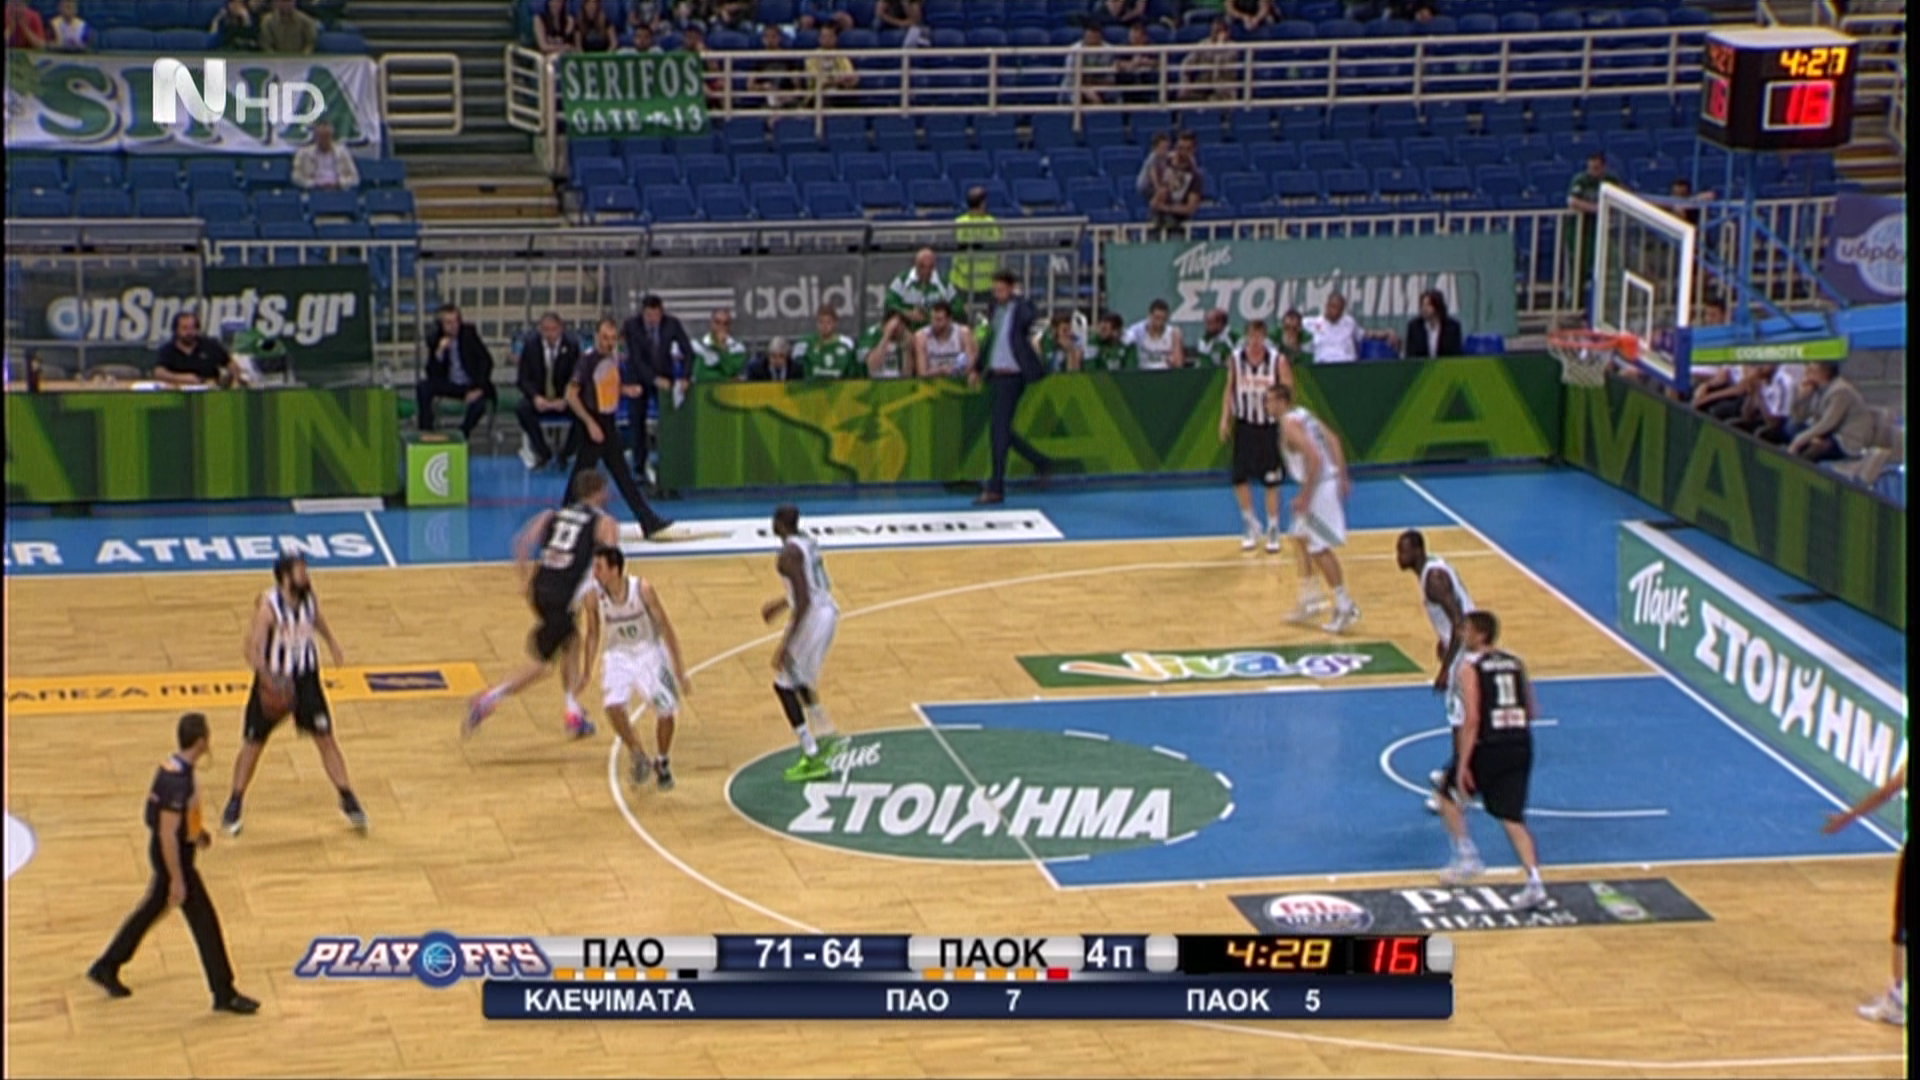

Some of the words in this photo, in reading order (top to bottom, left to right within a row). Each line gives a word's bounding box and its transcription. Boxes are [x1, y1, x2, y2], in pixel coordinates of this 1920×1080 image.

[565, 55, 700, 101] SERIFOS
[1779, 47, 1848, 77] 4:27
[573, 108, 642, 134] GATE
[1787, 82, 1834, 125] 16
[745, 275, 886, 320] adida
[97, 533, 375, 563] ATHENS
[1628, 560, 1689, 651] Πάμε
[1694, 599, 1905, 790] ΣΤΟΙΧΗΜ
[788, 777, 1171, 844] ΣΤΟΙΧΗΜΑ
